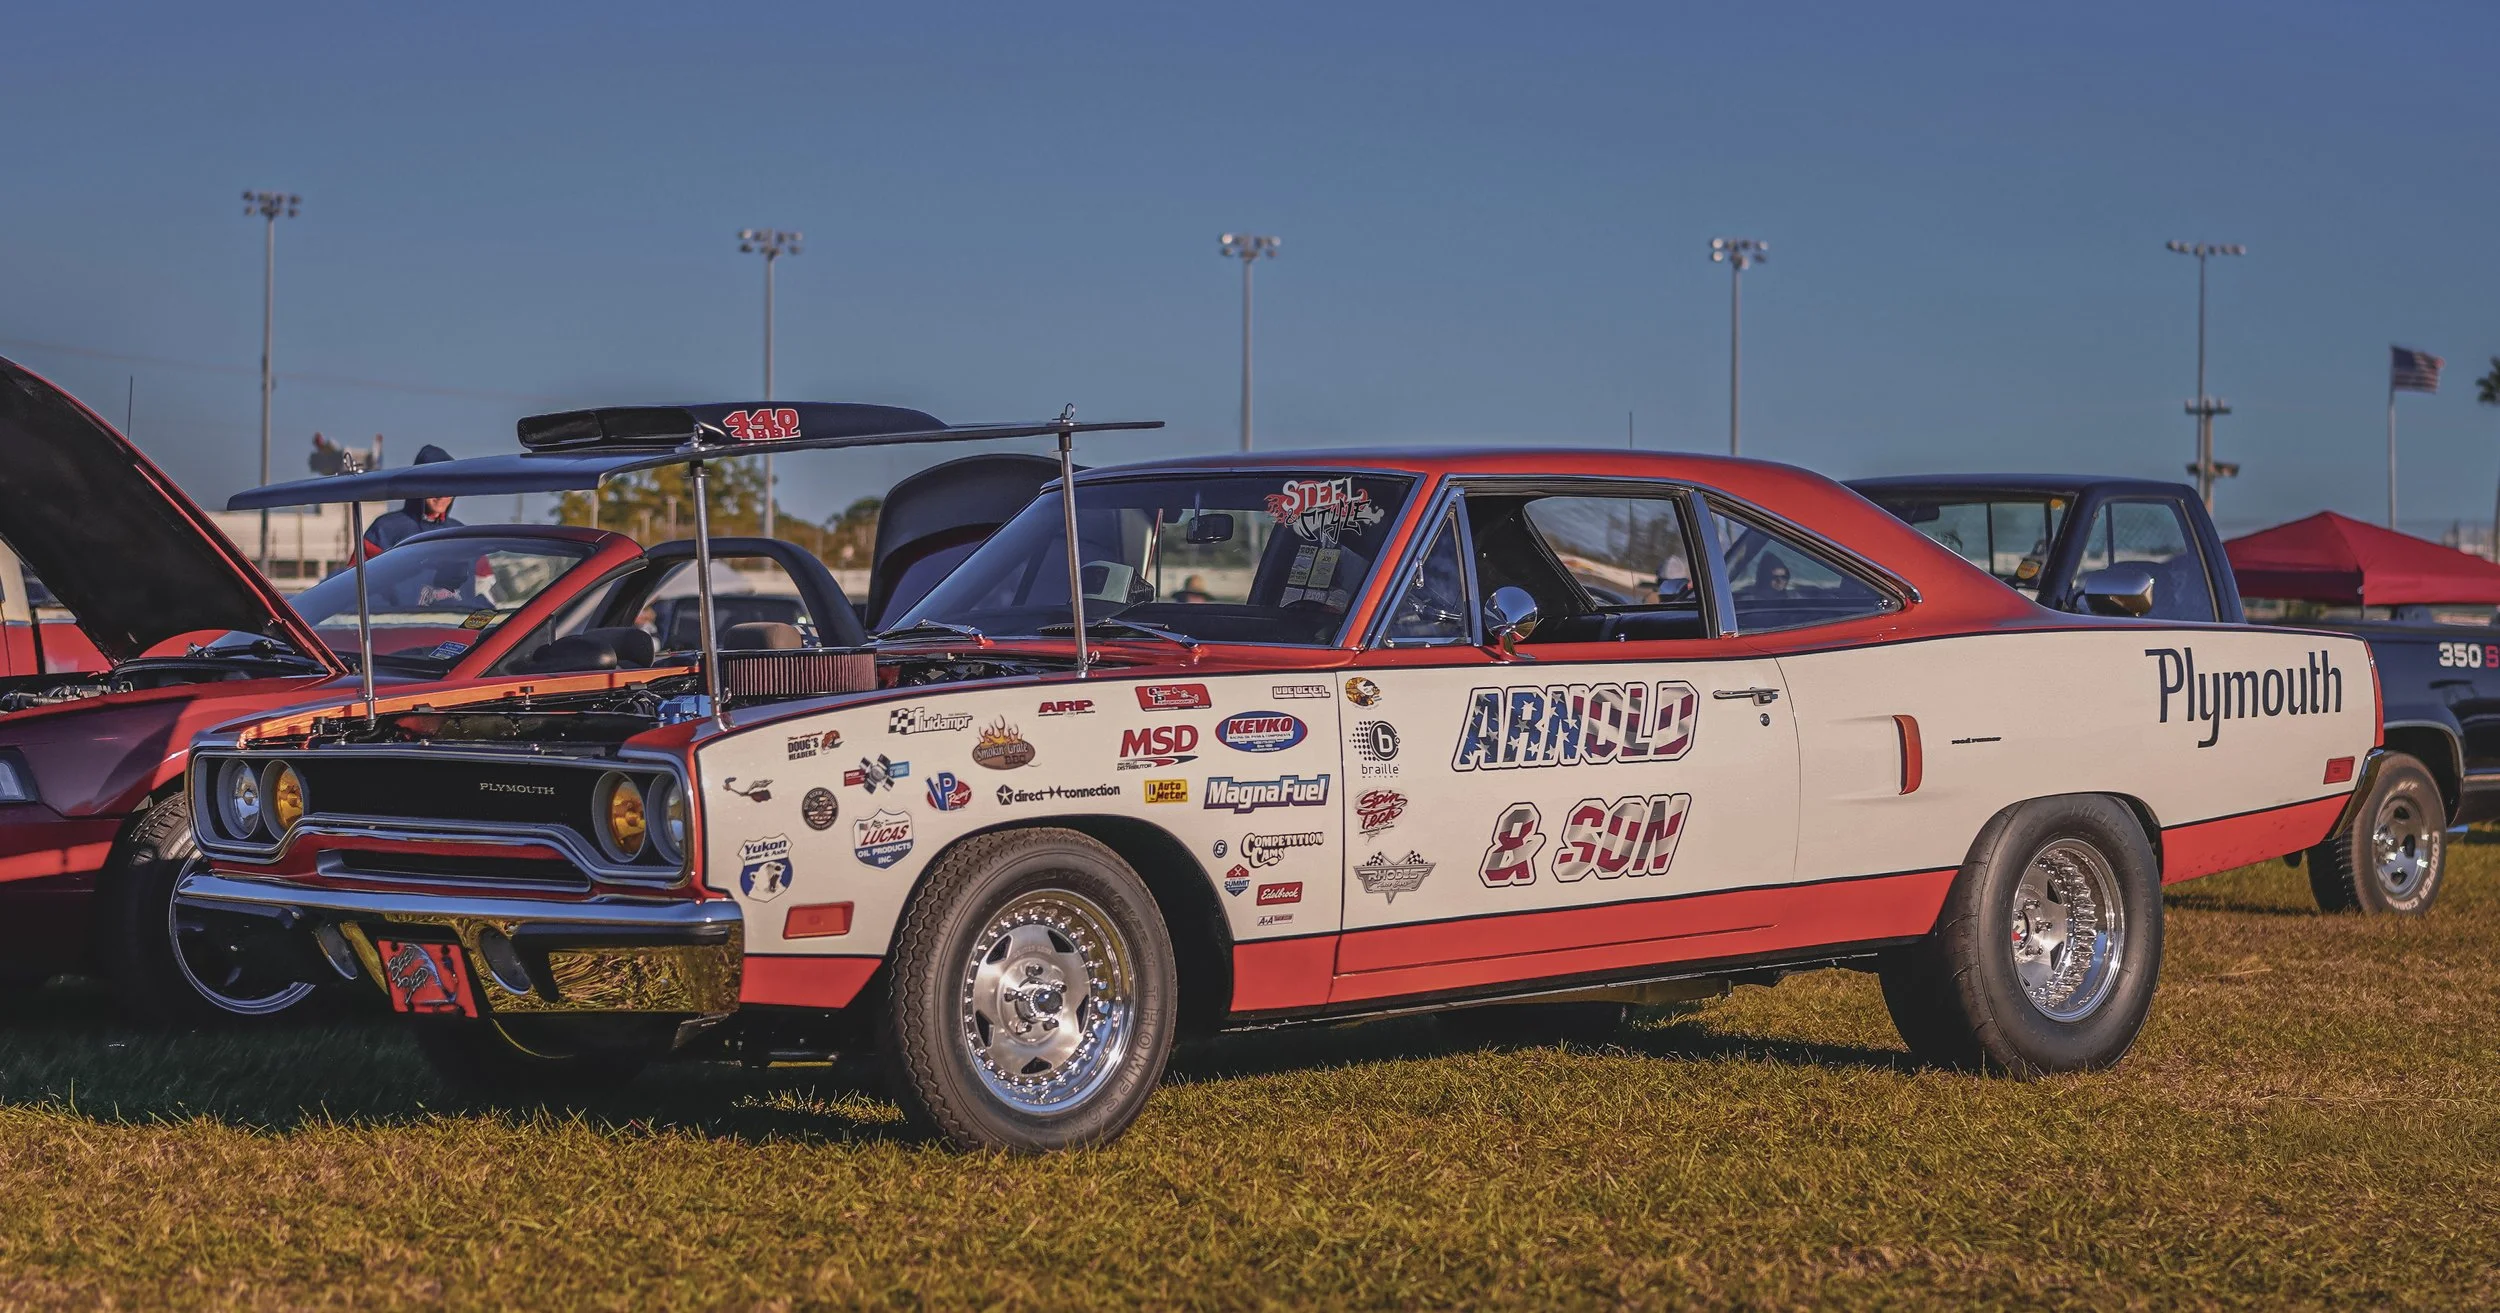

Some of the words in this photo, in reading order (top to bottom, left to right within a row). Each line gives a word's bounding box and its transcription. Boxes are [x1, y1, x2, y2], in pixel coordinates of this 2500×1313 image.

[723, 408, 799, 431] 440
[1282, 477, 1363, 512] STEEL
[1300, 500, 1372, 544] STYLE
[2438, 641, 2482, 668] 350
[1272, 685, 1331, 700] LUBELOCKER
[2145, 647, 2343, 748] Plymouth
[1038, 700, 1094, 713] ARP
[1228, 717, 1294, 735] KEVKO
[1452, 681, 1700, 772] ARNOLD
[788, 738, 819, 753] DOUG'S
[1120, 725, 1198, 757] MSD
[788, 750, 817, 761] HEADERS
[1361, 763, 1399, 775] braille
[480, 782, 555, 795] PLYMOUTH
[926, 772, 956, 811] VP
[1014, 788, 1046, 802] direct
[1064, 784, 1121, 799] connection
[1157, 791, 1186, 800] Meter
[1158, 782, 1181, 791] Auto
[1206, 776, 1328, 811] MagnaFuel
[1360, 790, 1408, 809] Spin
[861, 824, 910, 846] LUCAS
[1479, 802, 1546, 888] &
[1552, 793, 1692, 883] SON
[744, 839, 787, 855] Yukon
[857, 849, 871, 858] OIL
[872, 841, 912, 855] PRODUCTS
[877, 855, 894, 865] INC.
[2419, 831, 2441, 899] COOPER
[1224, 880, 1251, 888] SUMMIT
[1260, 887, 1299, 900] Edelbrock
